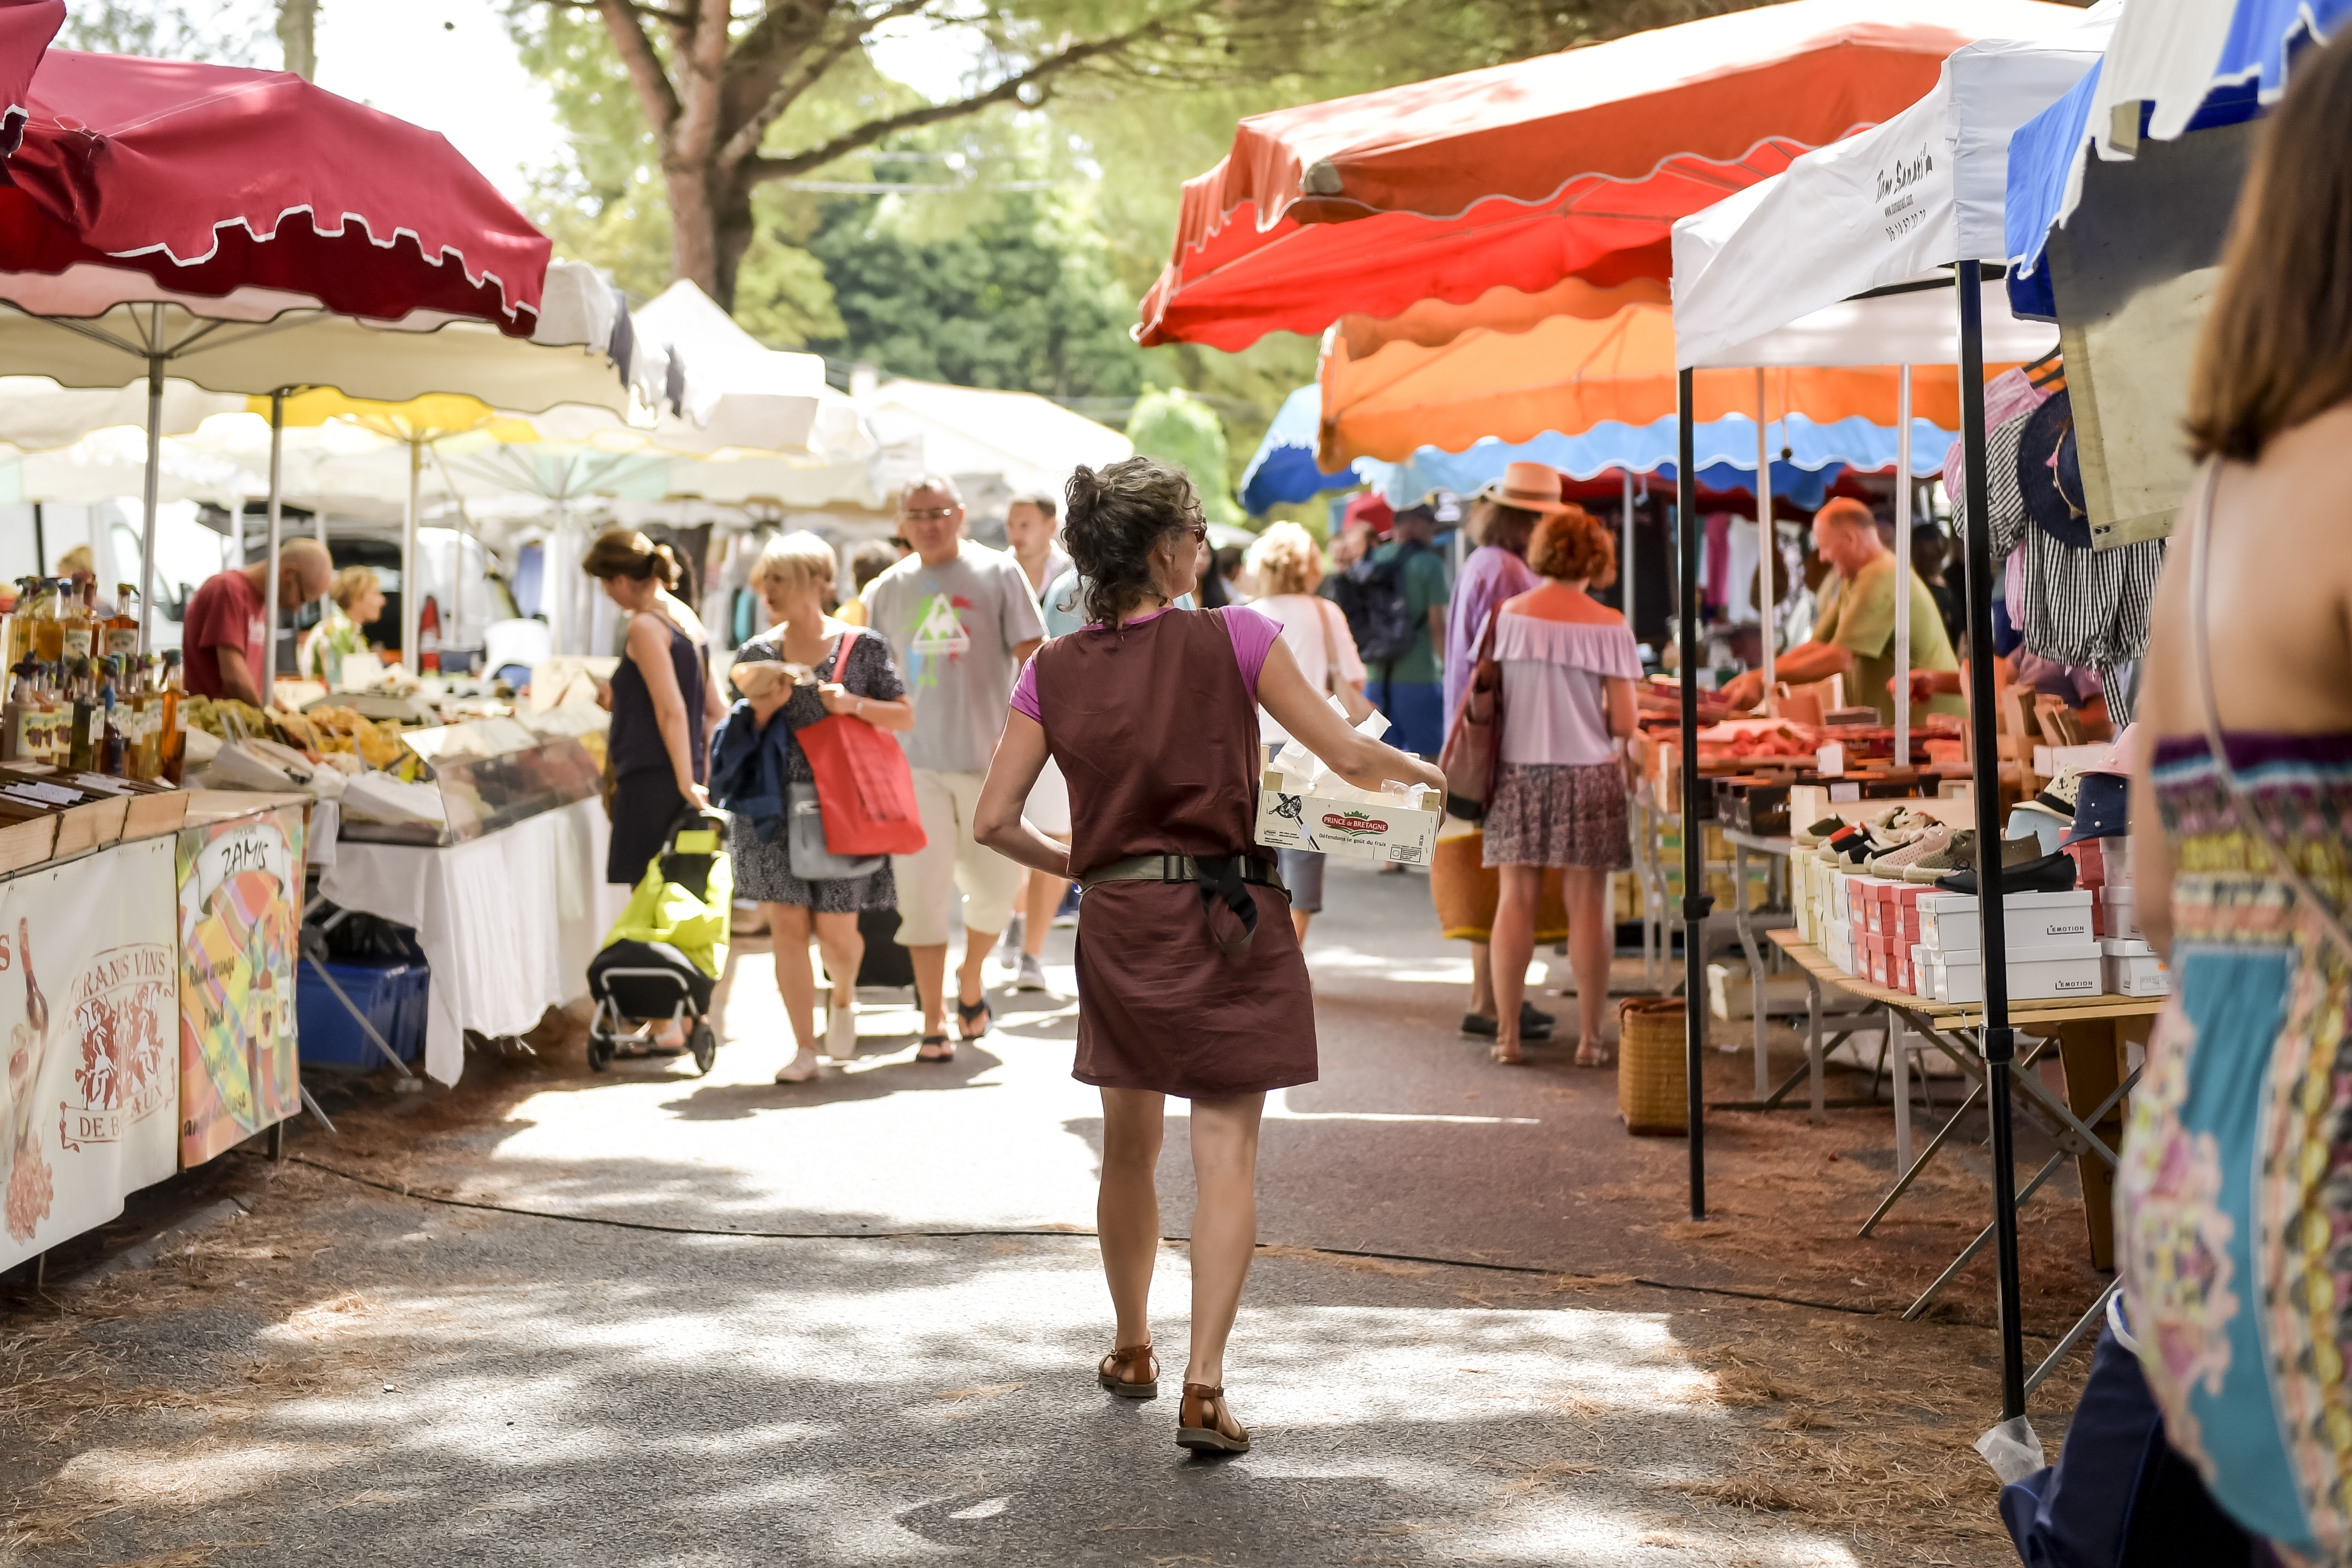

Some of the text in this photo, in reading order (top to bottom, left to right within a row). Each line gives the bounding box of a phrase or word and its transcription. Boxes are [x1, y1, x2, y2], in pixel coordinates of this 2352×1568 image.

[1885, 226, 1895, 242] 06
[1323, 817, 1346, 825] PRINCE
[1353, 821, 1386, 831] BRETAGNE
[1319, 833, 1346, 842] Défendons
[222, 838, 269, 878] ZAMIS
[135, 948, 165, 976] VINS
[79, 1116, 104, 1137] DE
